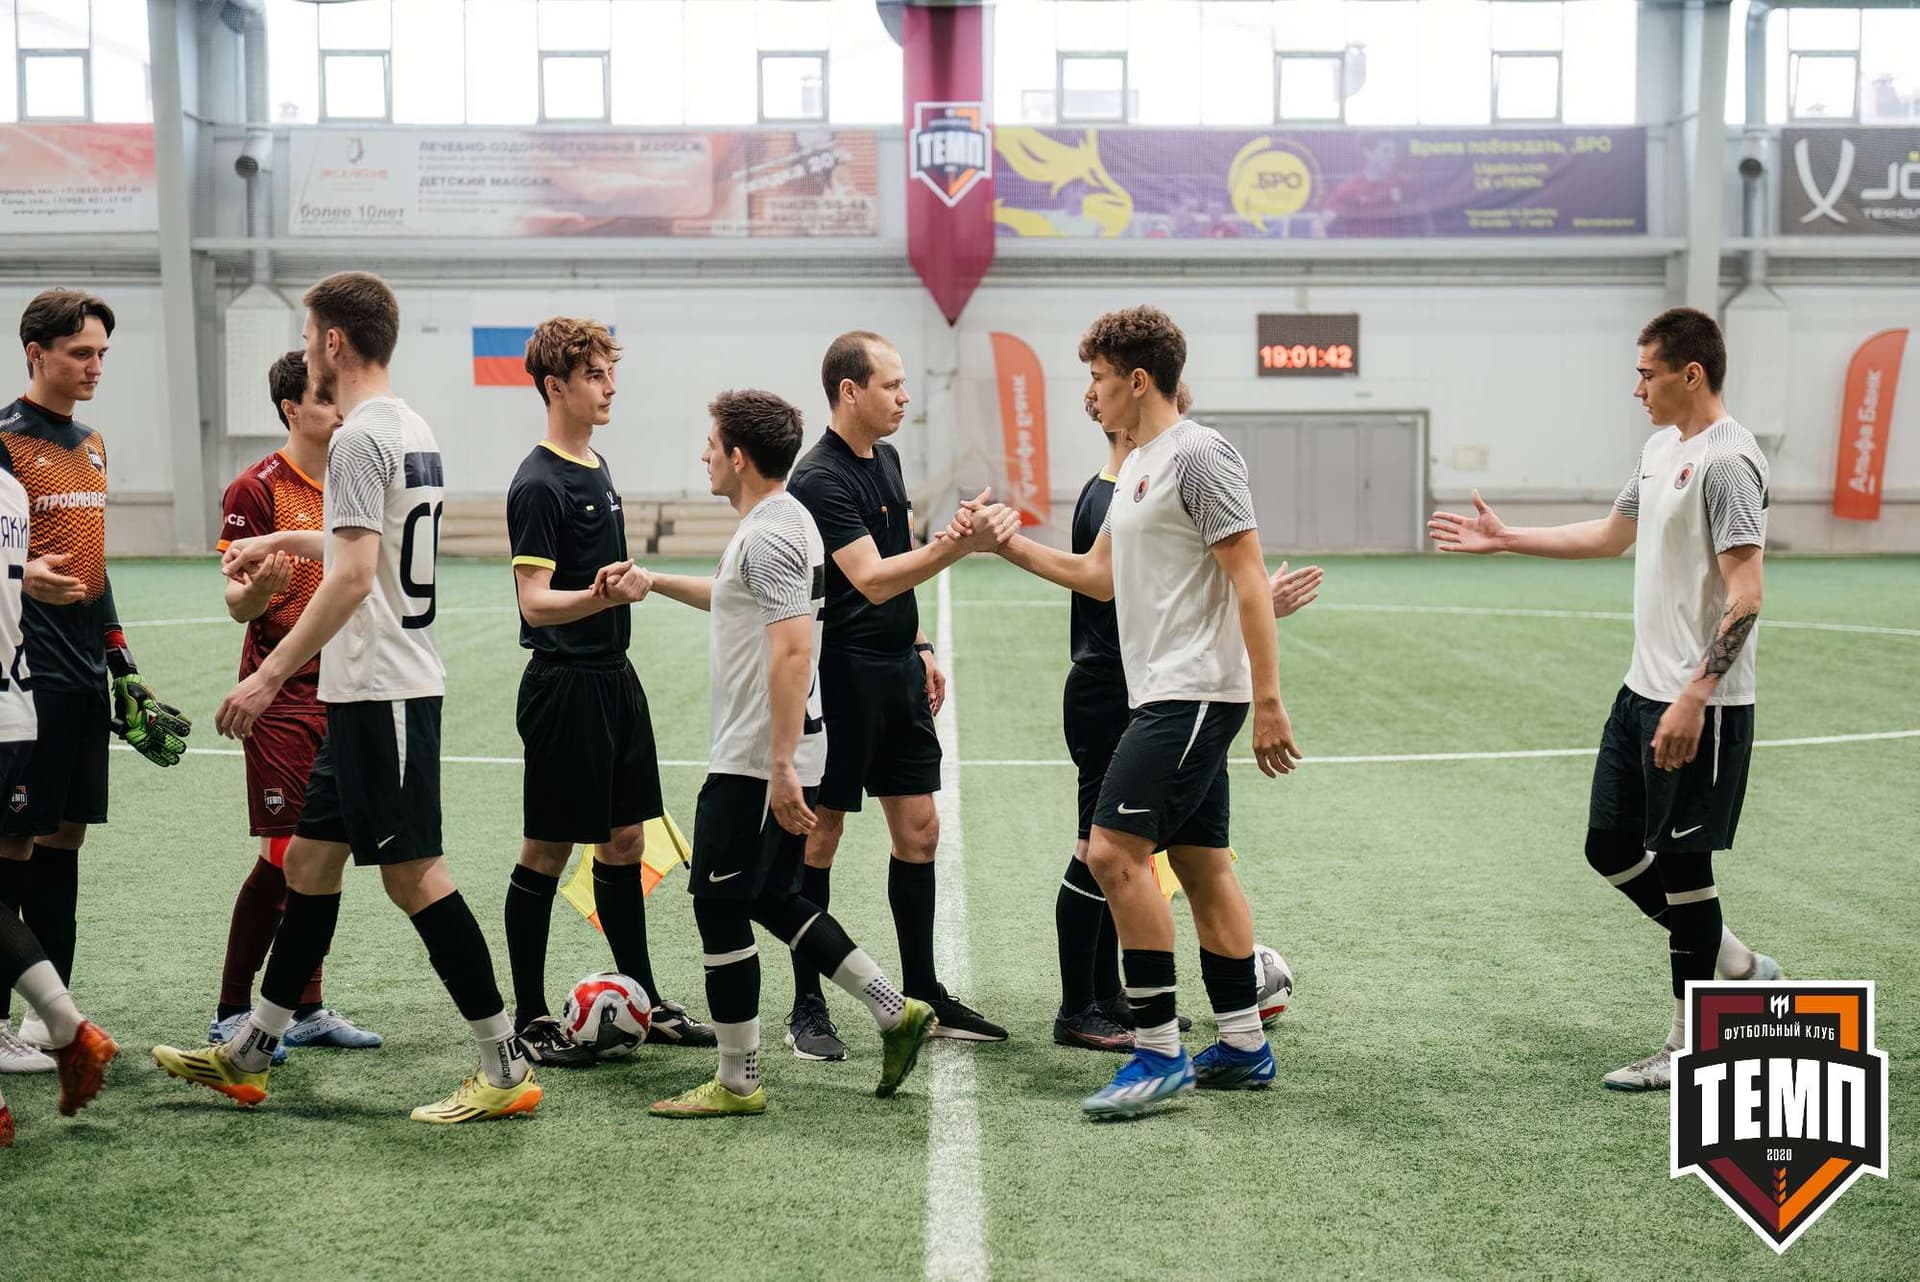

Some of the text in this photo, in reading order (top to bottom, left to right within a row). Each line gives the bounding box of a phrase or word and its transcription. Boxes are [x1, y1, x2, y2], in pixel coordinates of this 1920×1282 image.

[918, 131, 984, 168] ТЕМП
[418, 174, 486, 189] ДЕТСКИЙ
[1848, 368, 1883, 494] Альфа Банк
[224, 512, 246, 527] СБ
